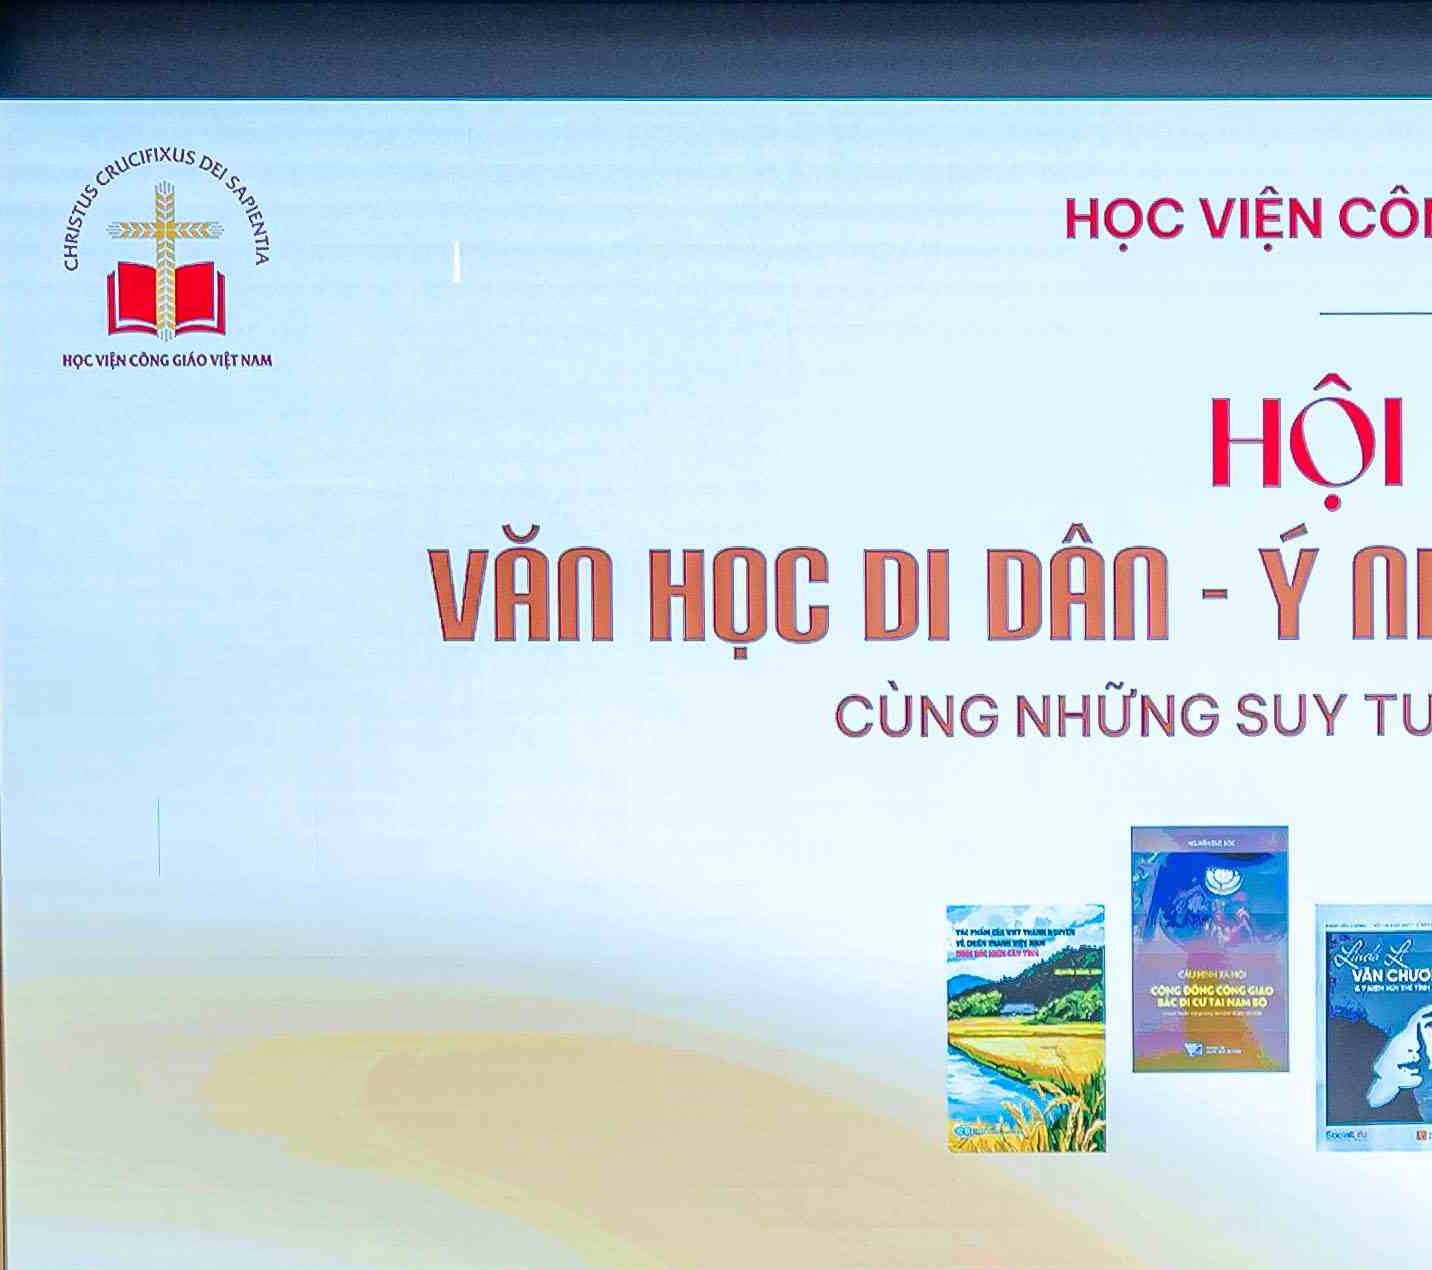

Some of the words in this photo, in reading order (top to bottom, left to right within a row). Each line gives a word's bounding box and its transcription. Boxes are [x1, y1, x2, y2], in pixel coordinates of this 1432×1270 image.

[64, 184, 98, 271] CHRISTUS
[96, 147, 195, 186] CRUCIFIXUS
[199, 155, 228, 180] DEI
[225, 176, 270, 265] SAPIENTIA
[1066, 197, 1184, 252] HỌC
[1199, 186, 1322, 252] VIỆN
[63, 354, 93, 369] HỌC
[96, 352, 126, 370] VIỆN
[129, 352, 168, 367] CÔNG
[172, 352, 207, 367] GIÁO
[210, 352, 238, 370] VIỆT
[241, 354, 273, 367] NAM
[1212, 373, 1403, 512] HỘI
[427, 524, 613, 642] VĂN
[649, 546, 829, 660] HỌC
[863, 547, 950, 641] DI
[987, 523, 1169, 641] DÂN
[1202, 588, 1230, 600] -
[1258, 522, 1322, 640] Ý
[835, 680, 998, 737] CÙNG
[1016, 681, 1219, 737] NHỮNG
[1236, 693, 1348, 737] SUY
